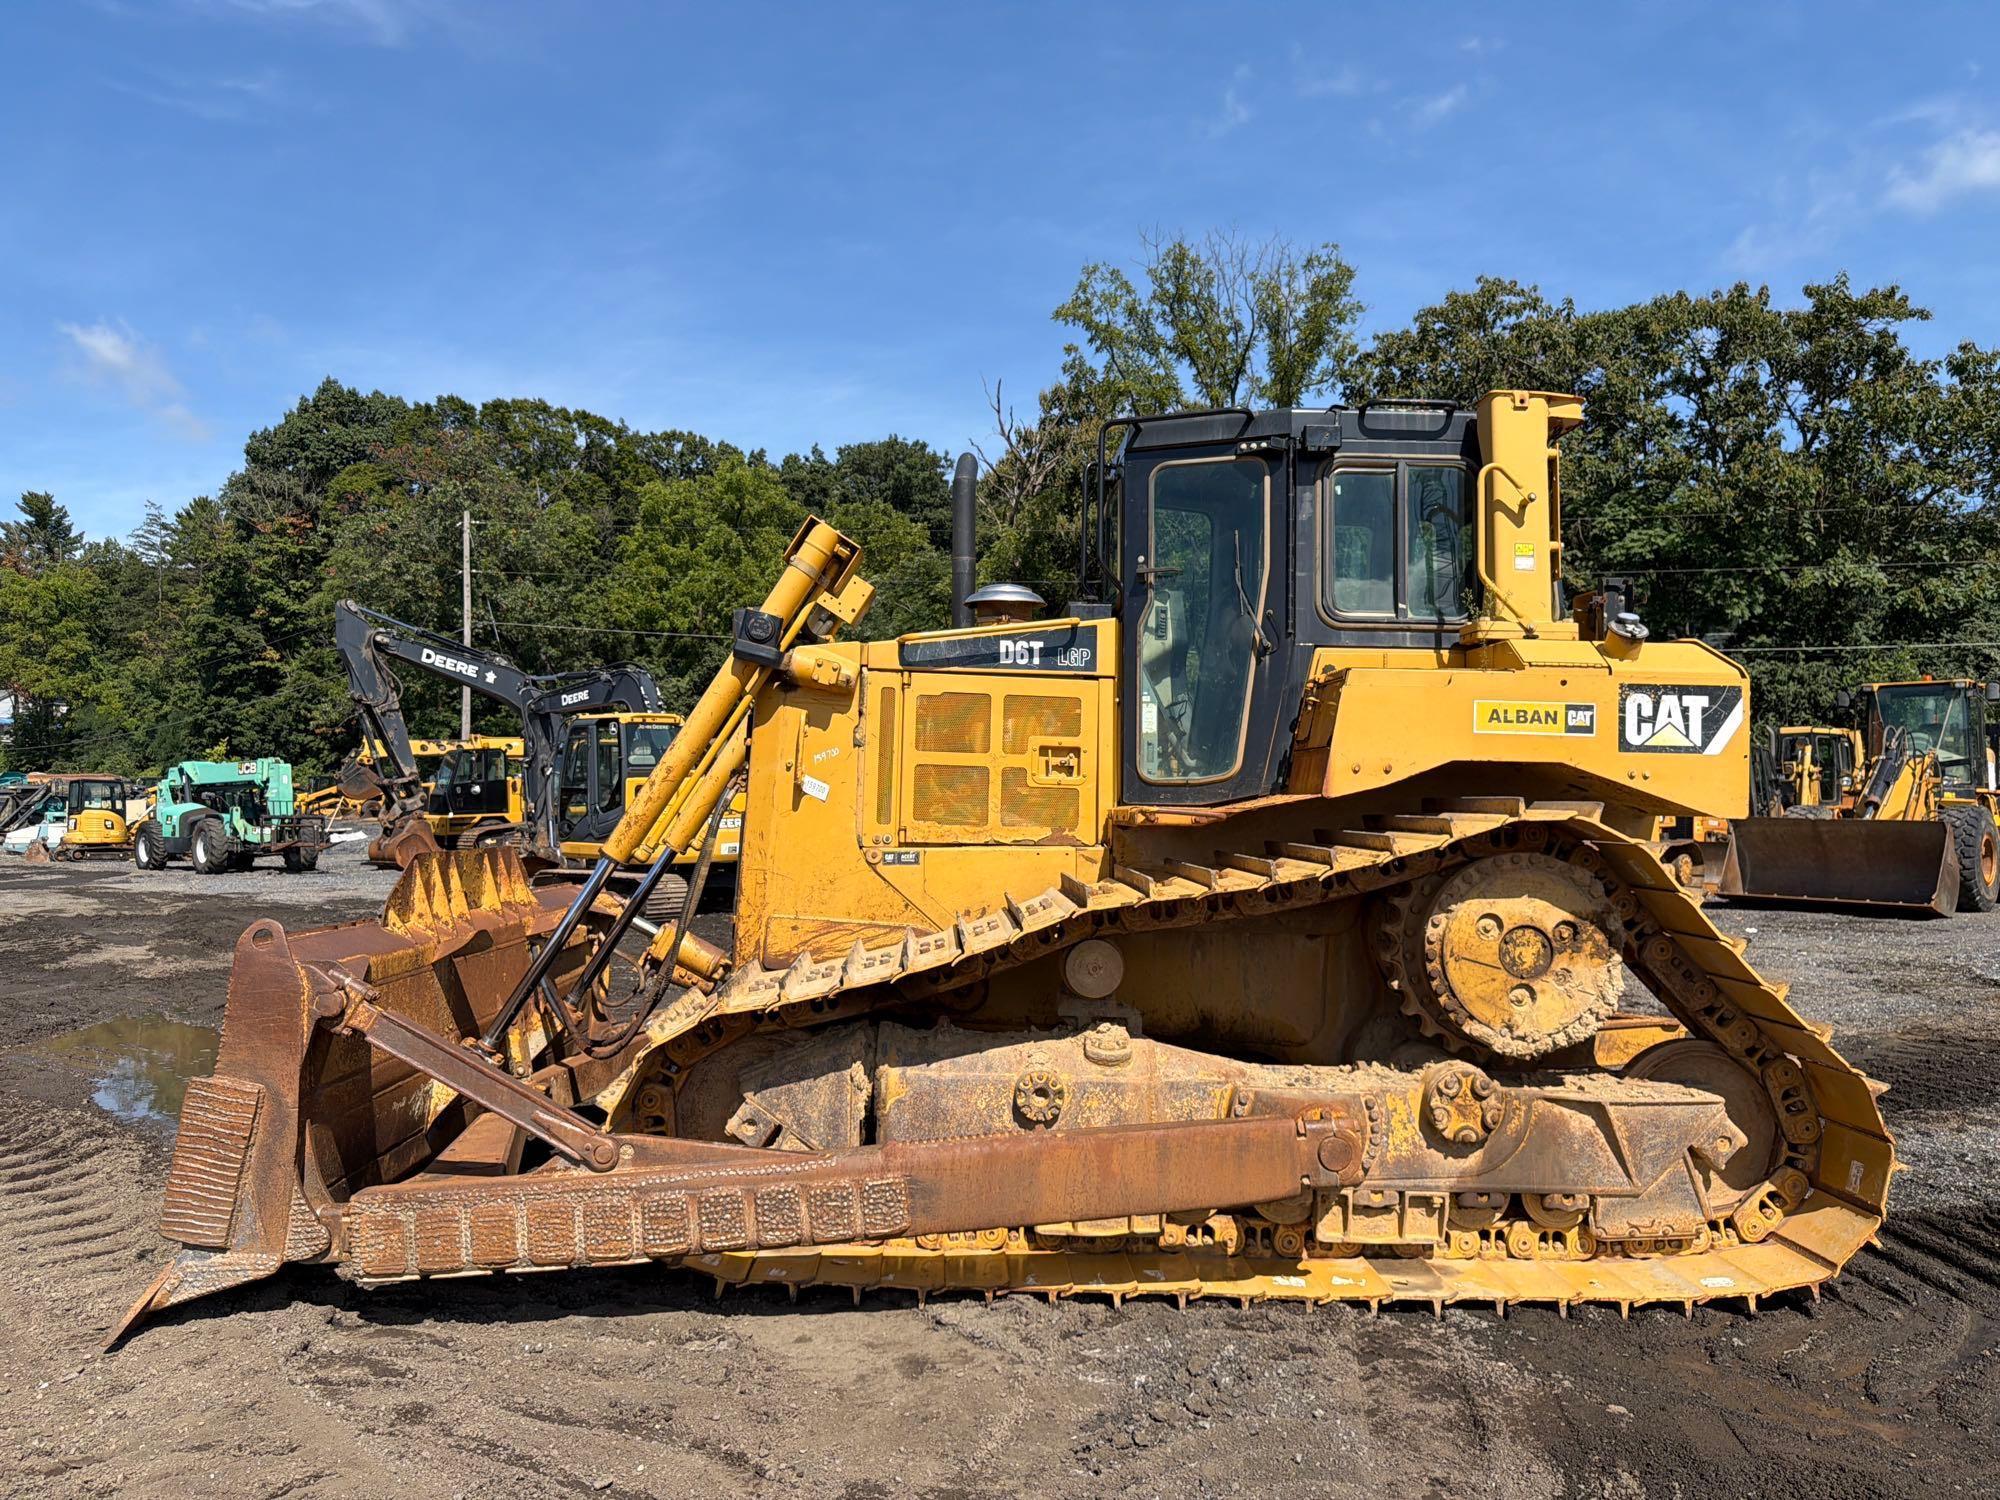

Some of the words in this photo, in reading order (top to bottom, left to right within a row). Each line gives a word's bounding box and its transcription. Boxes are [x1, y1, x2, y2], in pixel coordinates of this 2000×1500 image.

[1000, 640, 1044, 665] D6T
[1057, 648, 1091, 666] LGP
[421, 648, 479, 678] DEERE
[561, 690, 589, 706] DEERE
[1488, 708, 1558, 725] ALBAN
[1567, 710, 1594, 726] CAT
[1625, 693, 1709, 746] CAT
[238, 762, 257, 774] JCB
